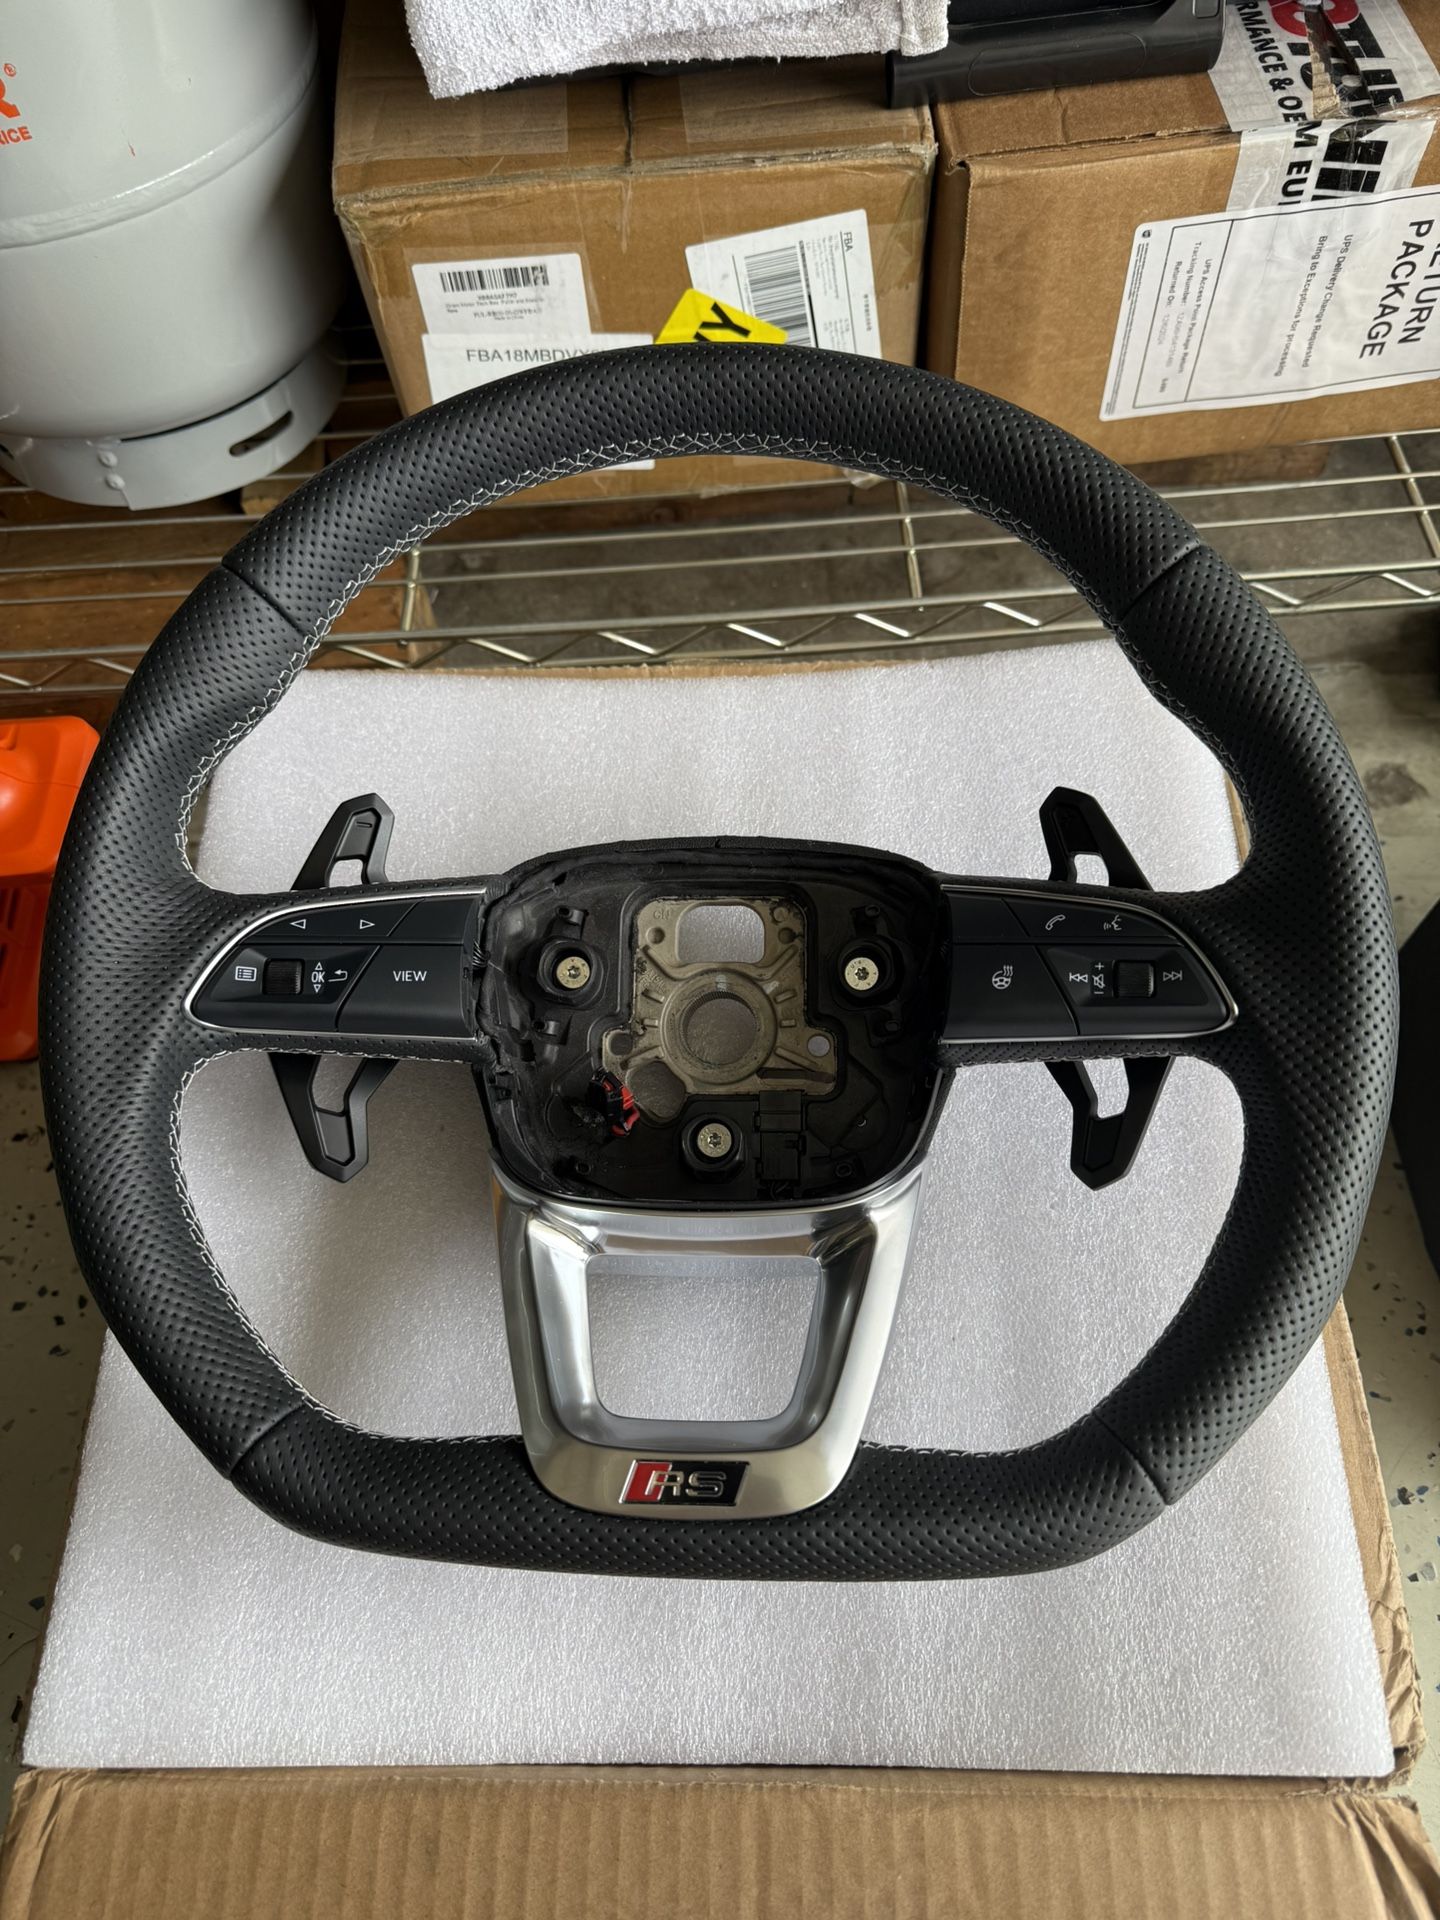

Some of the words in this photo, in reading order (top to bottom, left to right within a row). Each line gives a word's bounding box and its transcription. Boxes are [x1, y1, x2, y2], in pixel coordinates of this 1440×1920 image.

[1268, 77, 1294, 92] &
[1277, 96, 1323, 149] OEM
[1277, 160, 1313, 206] EU
[844, 232, 853, 252] FBA
[1311, 235, 1328, 260] Bring
[1340, 234, 1354, 254] UPS
[1186, 241, 1202, 274] Tracking
[1202, 258, 1212, 275] UPS
[1309, 261, 1319, 271] to
[1169, 261, 1182, 297] Returned
[1325, 256, 1346, 291] Delivery
[1180, 274, 1193, 306] Number:
[1196, 276, 1208, 303] Access
[1294, 272, 1316, 319] Exceptions
[1358, 219, 1435, 359] PACKAGE
[1315, 292, 1333, 323] Change
[1183, 321, 1197, 350] Package
[1291, 320, 1300, 332] for
[1274, 334, 1294, 377] processing
[1302, 325, 1321, 368] Requested
[311, 971, 326, 983] OK
[393, 970, 428, 982] VIEW
[644, 1470, 727, 1498] RS
